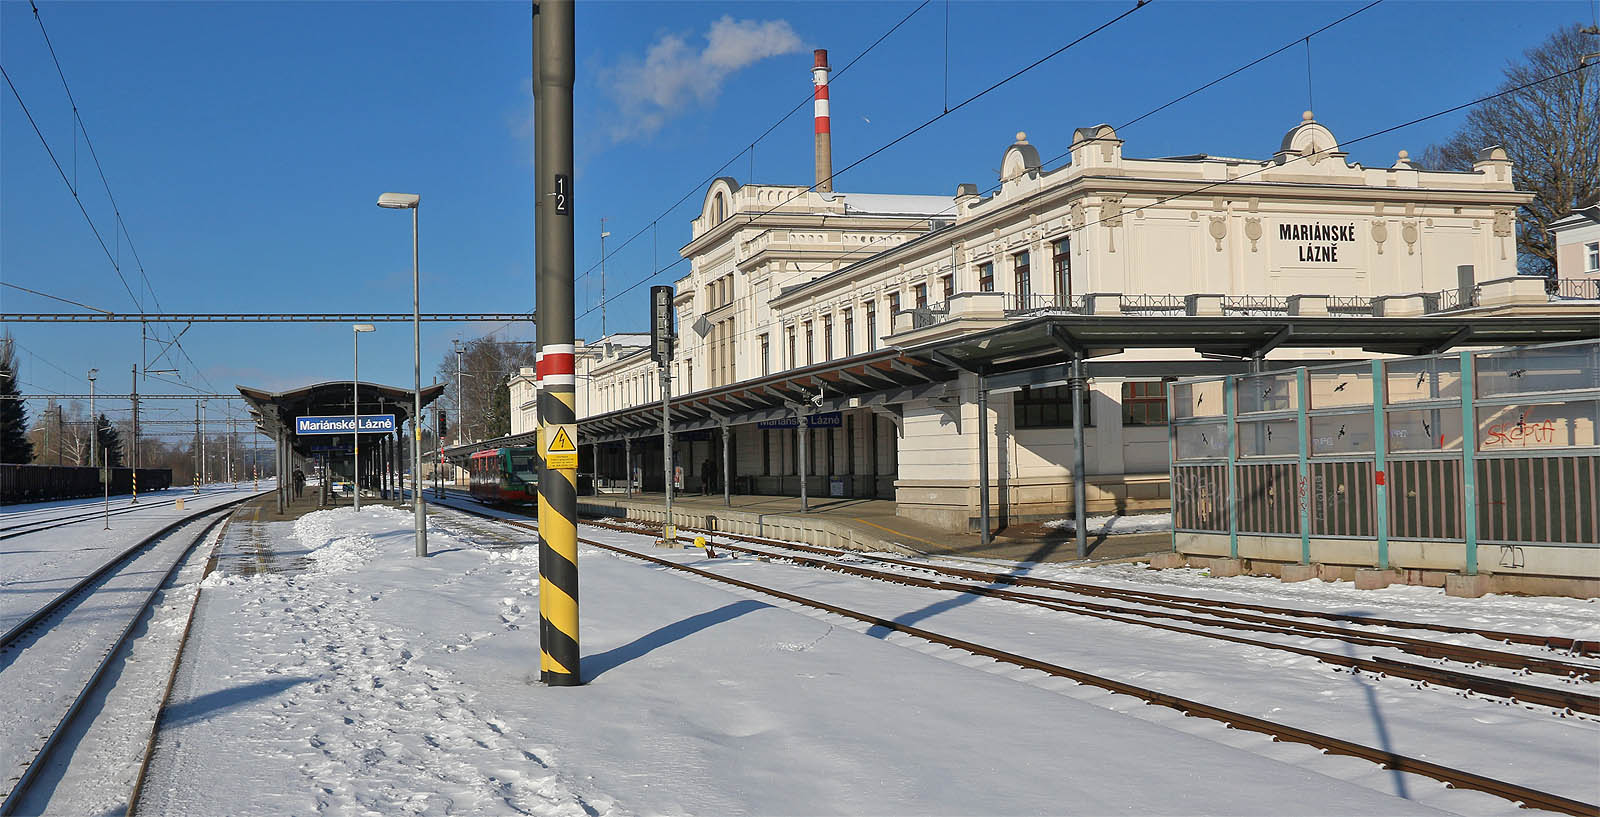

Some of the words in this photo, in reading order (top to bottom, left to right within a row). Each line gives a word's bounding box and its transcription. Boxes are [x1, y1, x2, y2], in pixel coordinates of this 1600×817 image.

[1279, 222, 1355, 241] MARIÁNSKÉ
[1299, 243, 1338, 262] LÁZNĚ
[300, 420, 355, 430] Mariánské
[358, 419, 392, 428] Lázně
